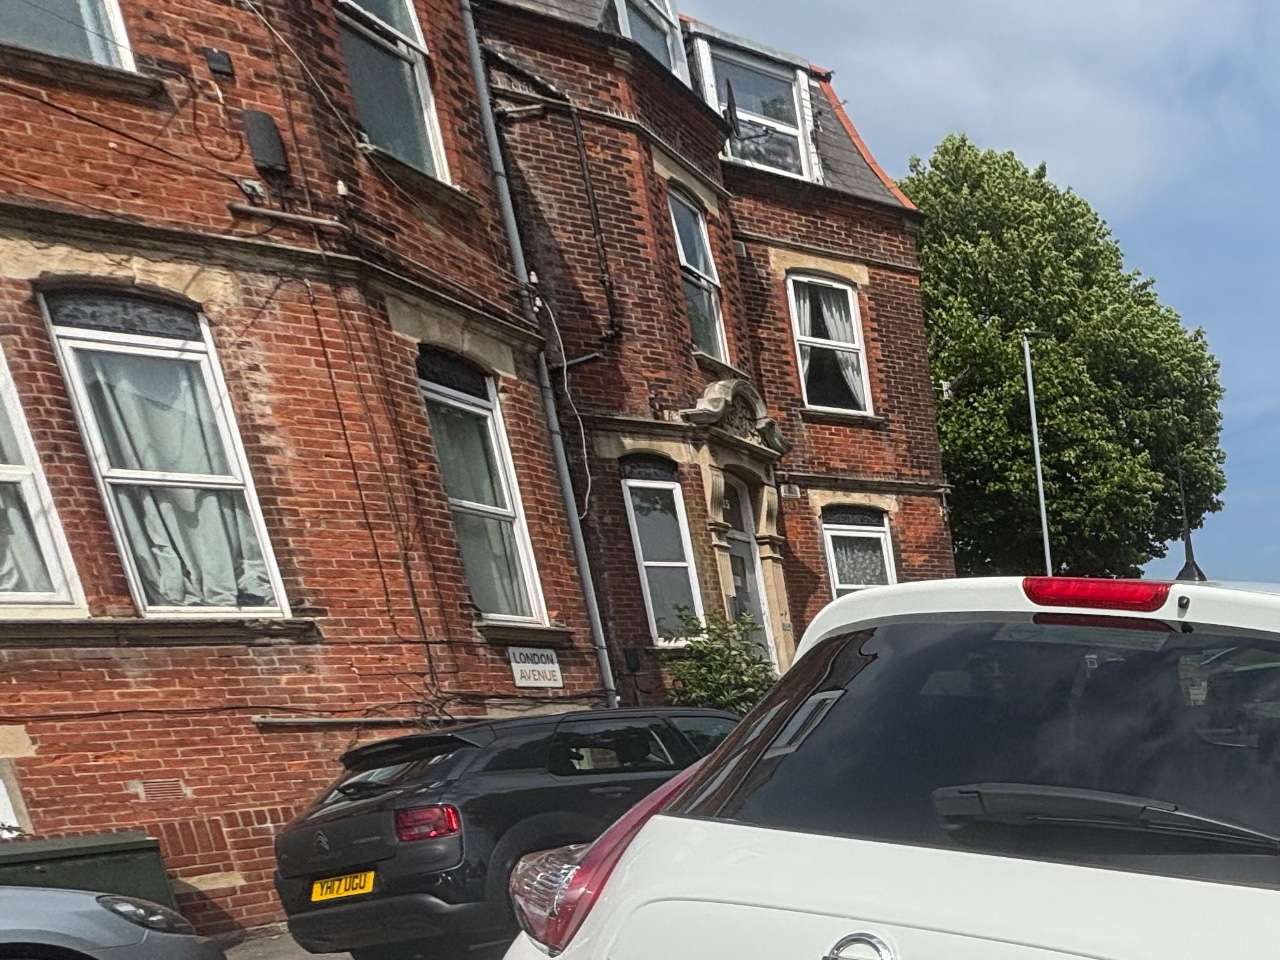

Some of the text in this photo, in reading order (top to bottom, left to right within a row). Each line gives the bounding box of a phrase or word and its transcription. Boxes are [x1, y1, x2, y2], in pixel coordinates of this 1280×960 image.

[512, 652, 555, 665] LONDON
[520, 669, 558, 682] AVENUE
[320, 879, 344, 896] YH17
